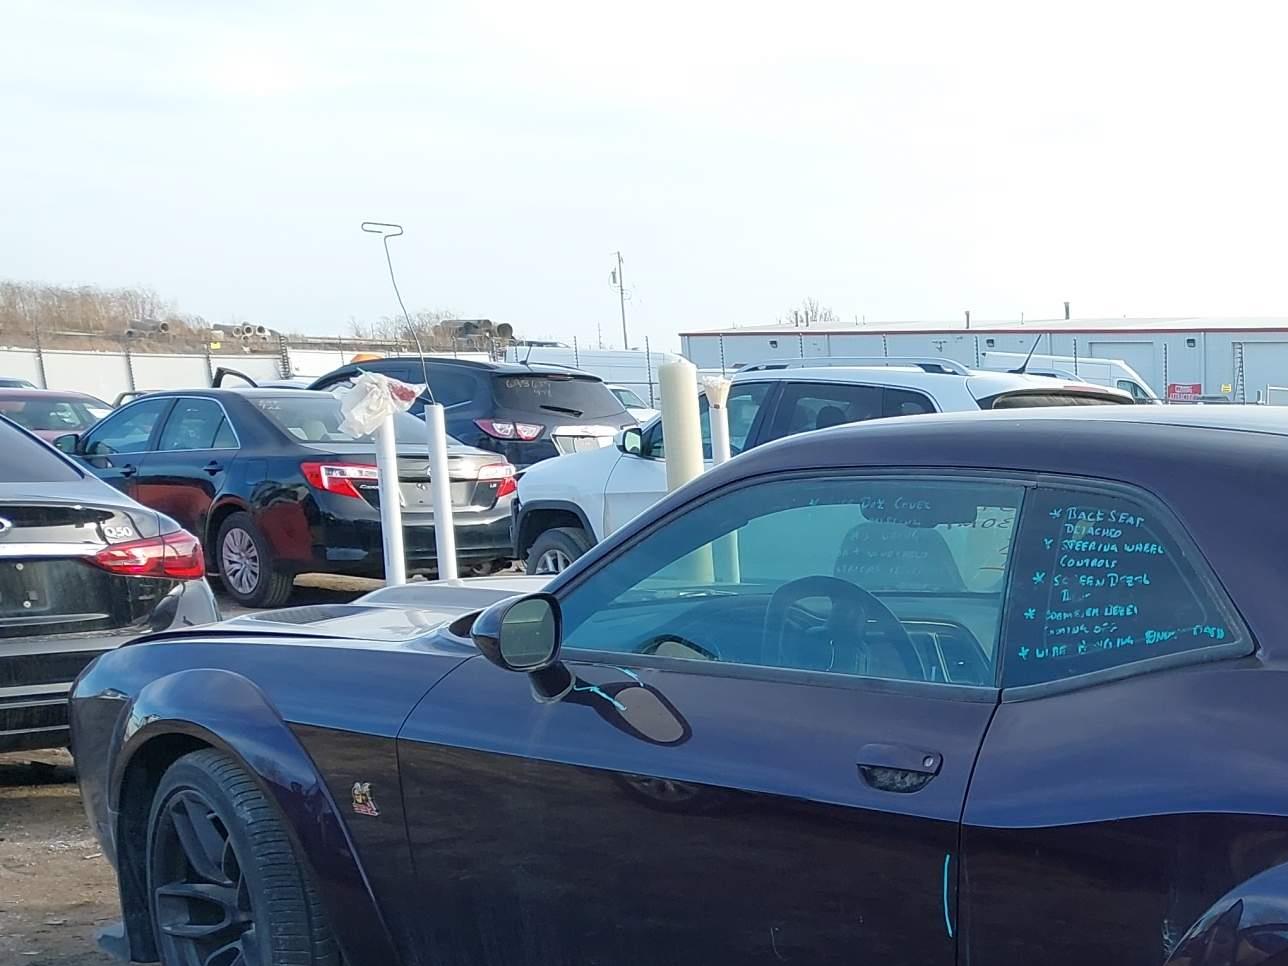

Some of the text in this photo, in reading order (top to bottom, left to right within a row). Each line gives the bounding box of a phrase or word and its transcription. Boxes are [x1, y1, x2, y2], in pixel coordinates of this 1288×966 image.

[1109, 510, 1145, 528] SEAT
[104, 526, 133, 539] Q50
[1061, 540, 1165, 554] STEERING WHEEL
[1060, 554, 1118, 569] CONTROLS
